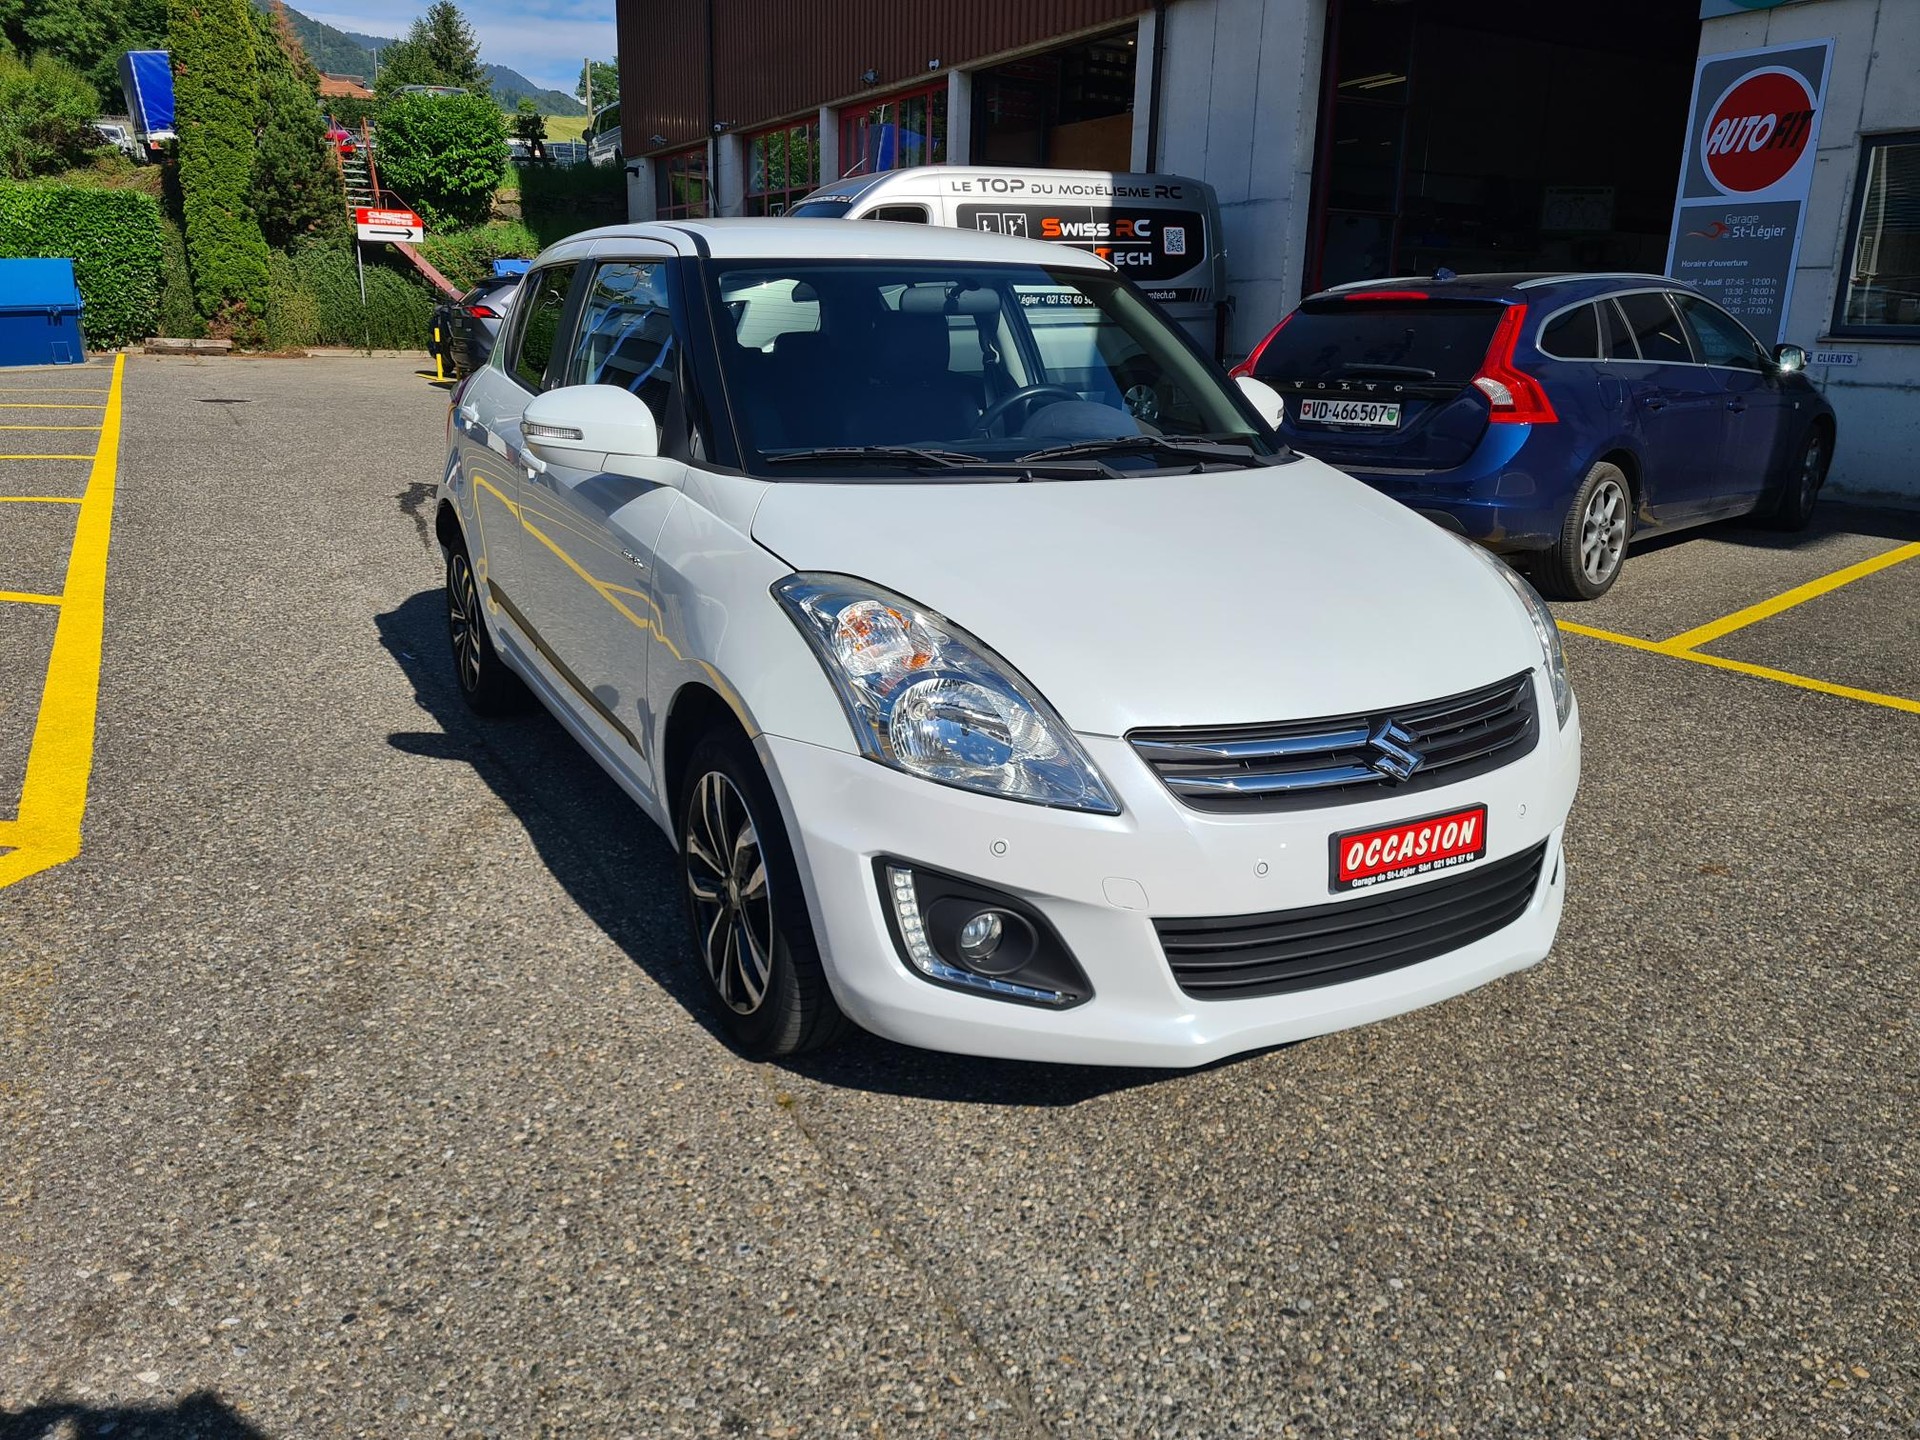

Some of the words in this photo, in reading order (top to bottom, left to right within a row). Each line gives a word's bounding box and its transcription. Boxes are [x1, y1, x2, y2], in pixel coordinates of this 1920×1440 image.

[952, 181, 972, 191] LE
[977, 178, 1025, 193] TOP
[1031, 183, 1053, 194] DU
[1058, 183, 1150, 197] MODÉLISME
[1155, 185, 1183, 199] RC
[1725, 214, 1759, 226] Garage
[1115, 219, 1151, 237] RC
[1732, 225, 1786, 239] St-Légier
[1682, 260, 1707, 268] Horaire
[1707, 259, 1748, 267] d'ouverture
[1751, 278, 1771, 286] 12:00
[1046, 295, 1058, 304] 021
[1059, 295, 1072, 304] 552
[1073, 295, 1083, 304] 60
[1818, 353, 1854, 364] CLIENTS
[1346, 816, 1477, 871] OCCASION
[1351, 876, 1376, 887] Garage
[1377, 874, 1386, 882] de
[1386, 867, 1416, 880] St-Légier
[1433, 860, 1445, 869] 021
